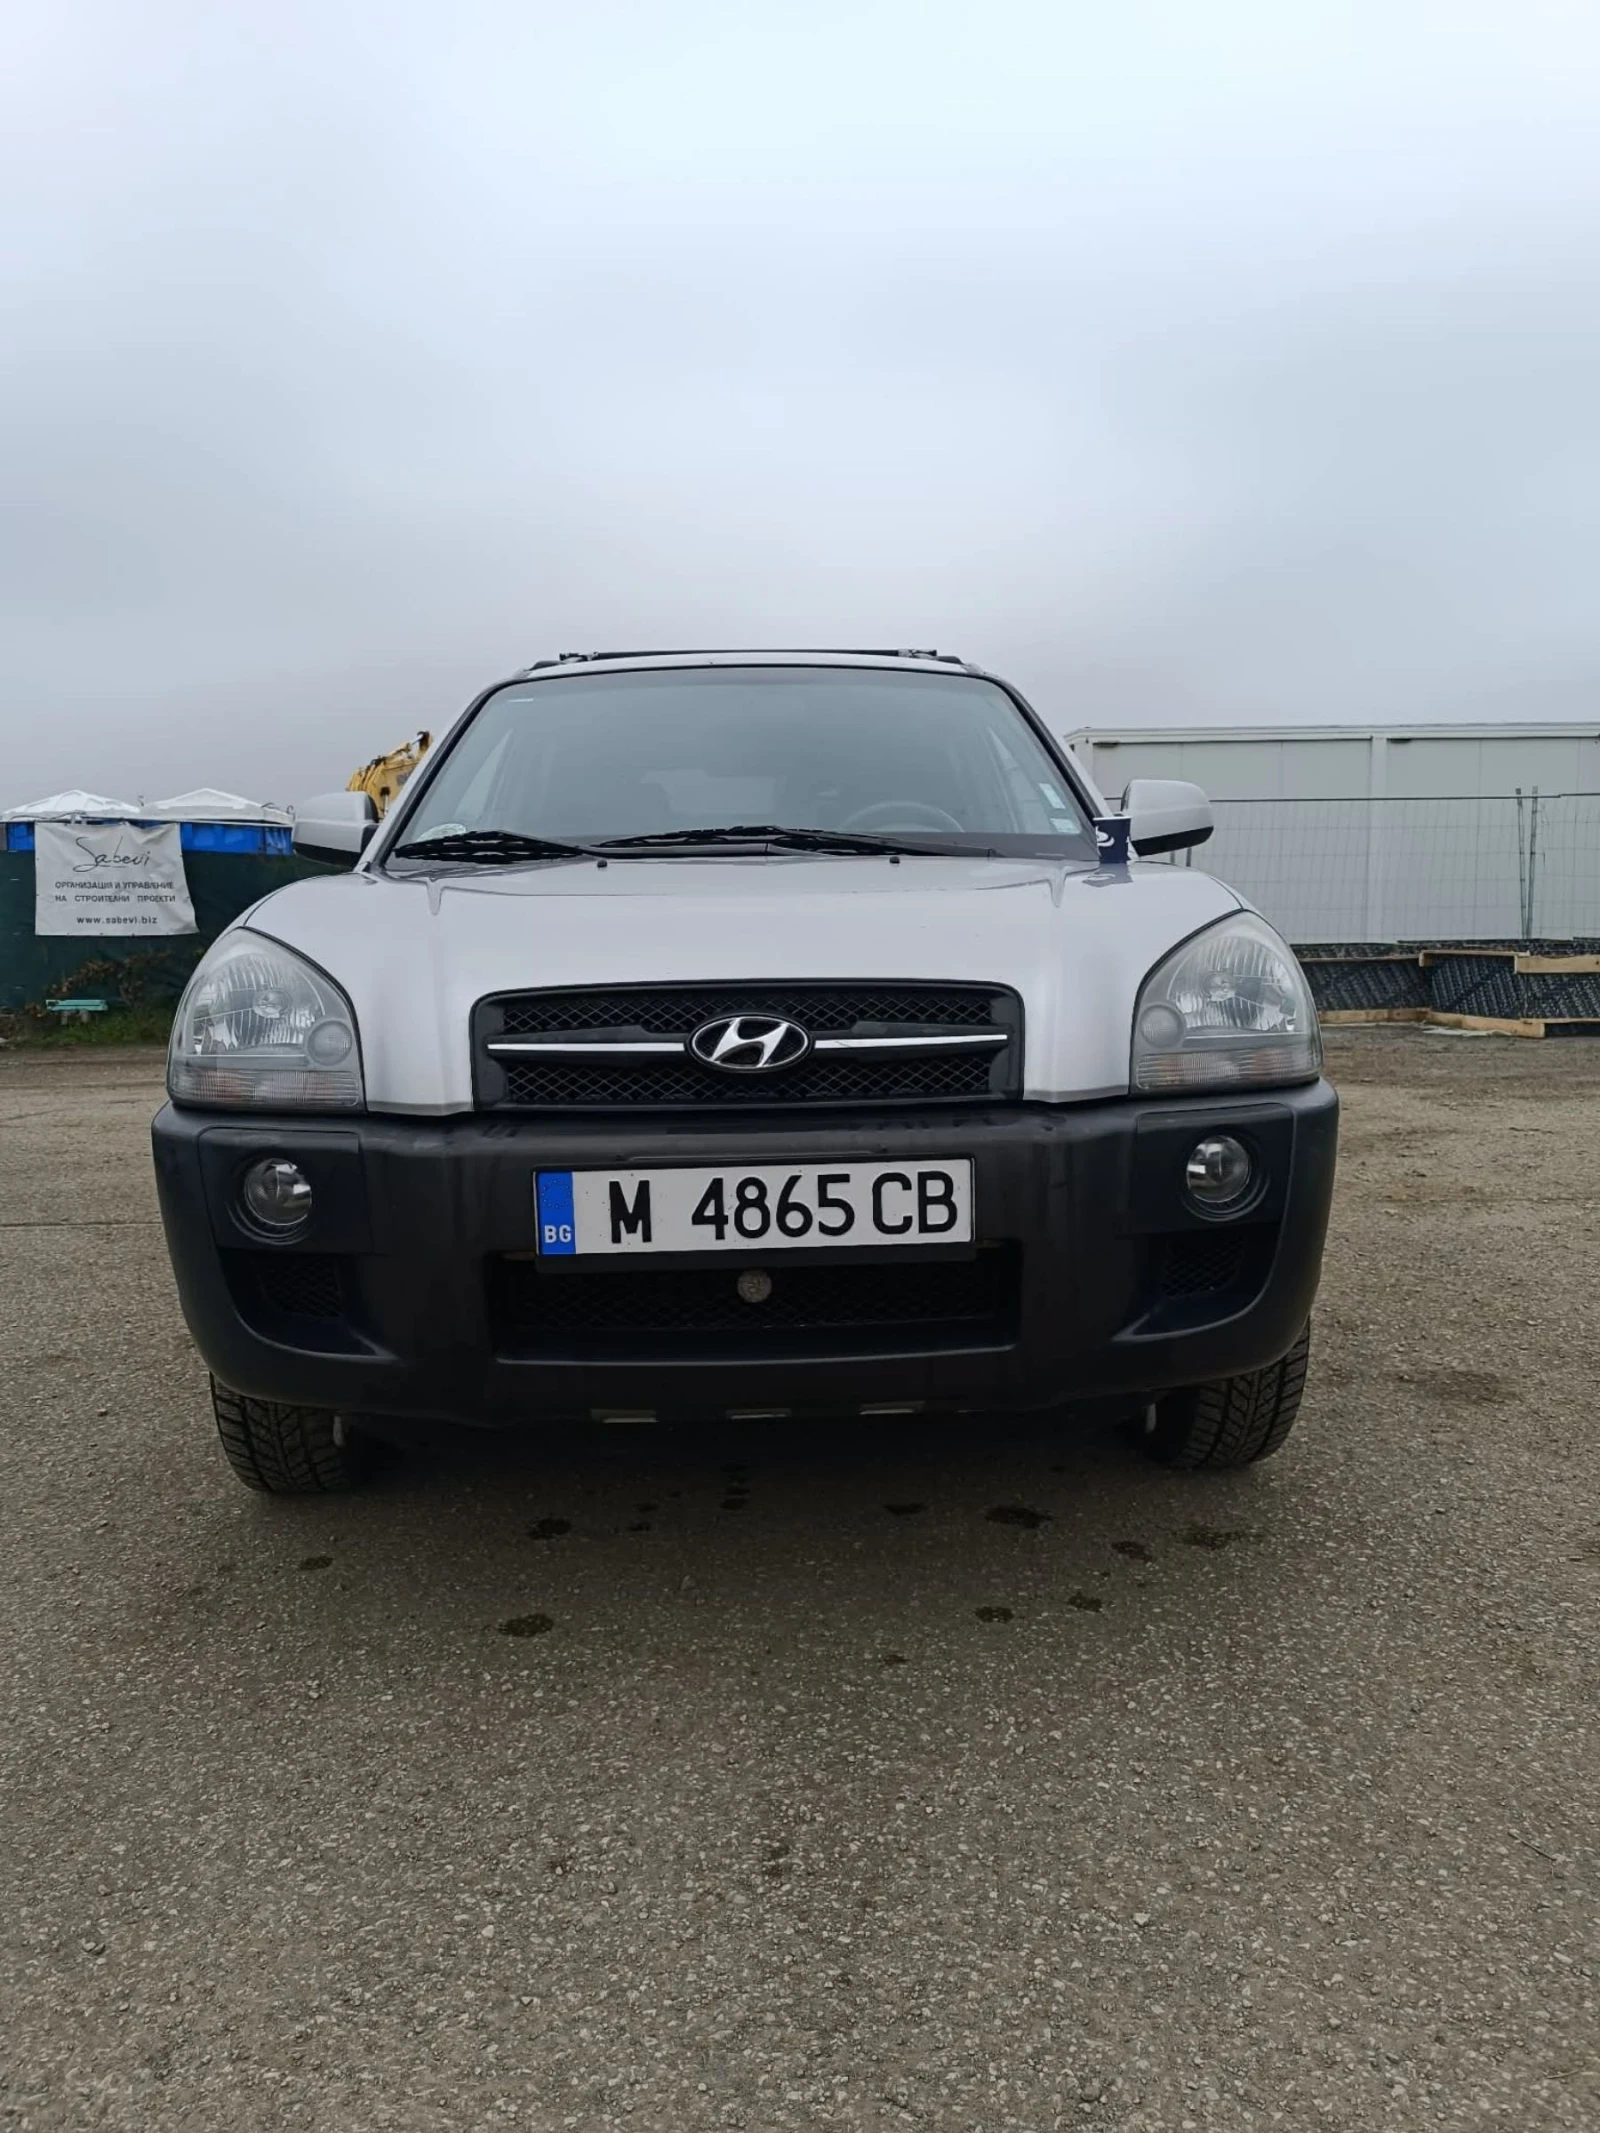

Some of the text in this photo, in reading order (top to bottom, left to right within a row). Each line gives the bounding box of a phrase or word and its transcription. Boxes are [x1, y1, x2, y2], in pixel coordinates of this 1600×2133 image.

[72, 836, 151, 873] Sabevi
[54, 881, 113, 890] ОРГАНИЗАЦИЯ
[123, 881, 175, 890] УПРАВЛЕНИЕ
[74, 895, 130, 903] СТРОИТЕЛНИ
[137, 895, 176, 903] ПРОЕКТИ
[76, 916, 158, 924] www.sabevi.biz
[608, 1170, 958, 1244] M 4865 CB
[544, 1225, 572, 1244] BG
